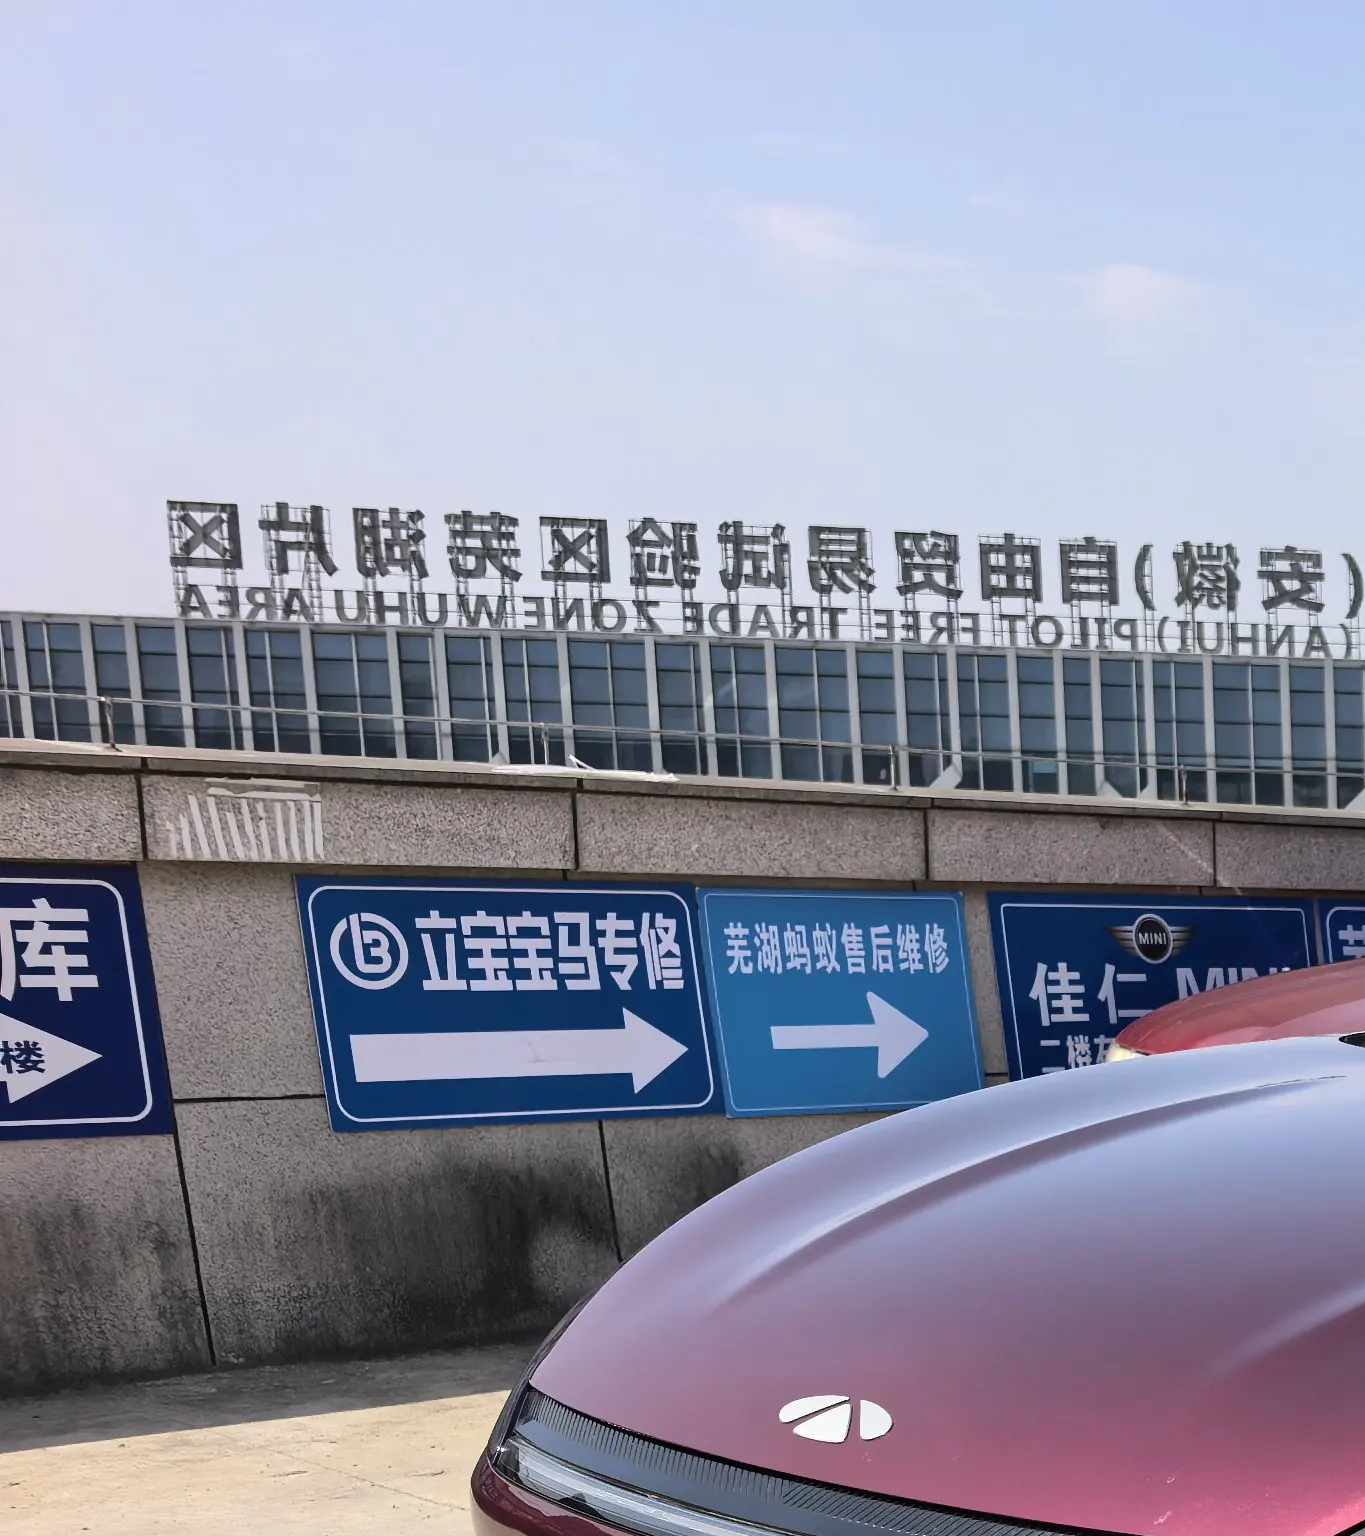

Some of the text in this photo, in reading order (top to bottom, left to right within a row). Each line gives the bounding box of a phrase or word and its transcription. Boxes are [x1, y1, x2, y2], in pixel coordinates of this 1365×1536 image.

[0, 897, 100, 1002] 库
[414, 909, 687, 992] 立宝宝马专修
[723, 920, 951, 976] 芜湖蚂蚁售后维修
[1137, 931, 1168, 946] MINI
[1028, 961, 1155, 1027] 佳仁
